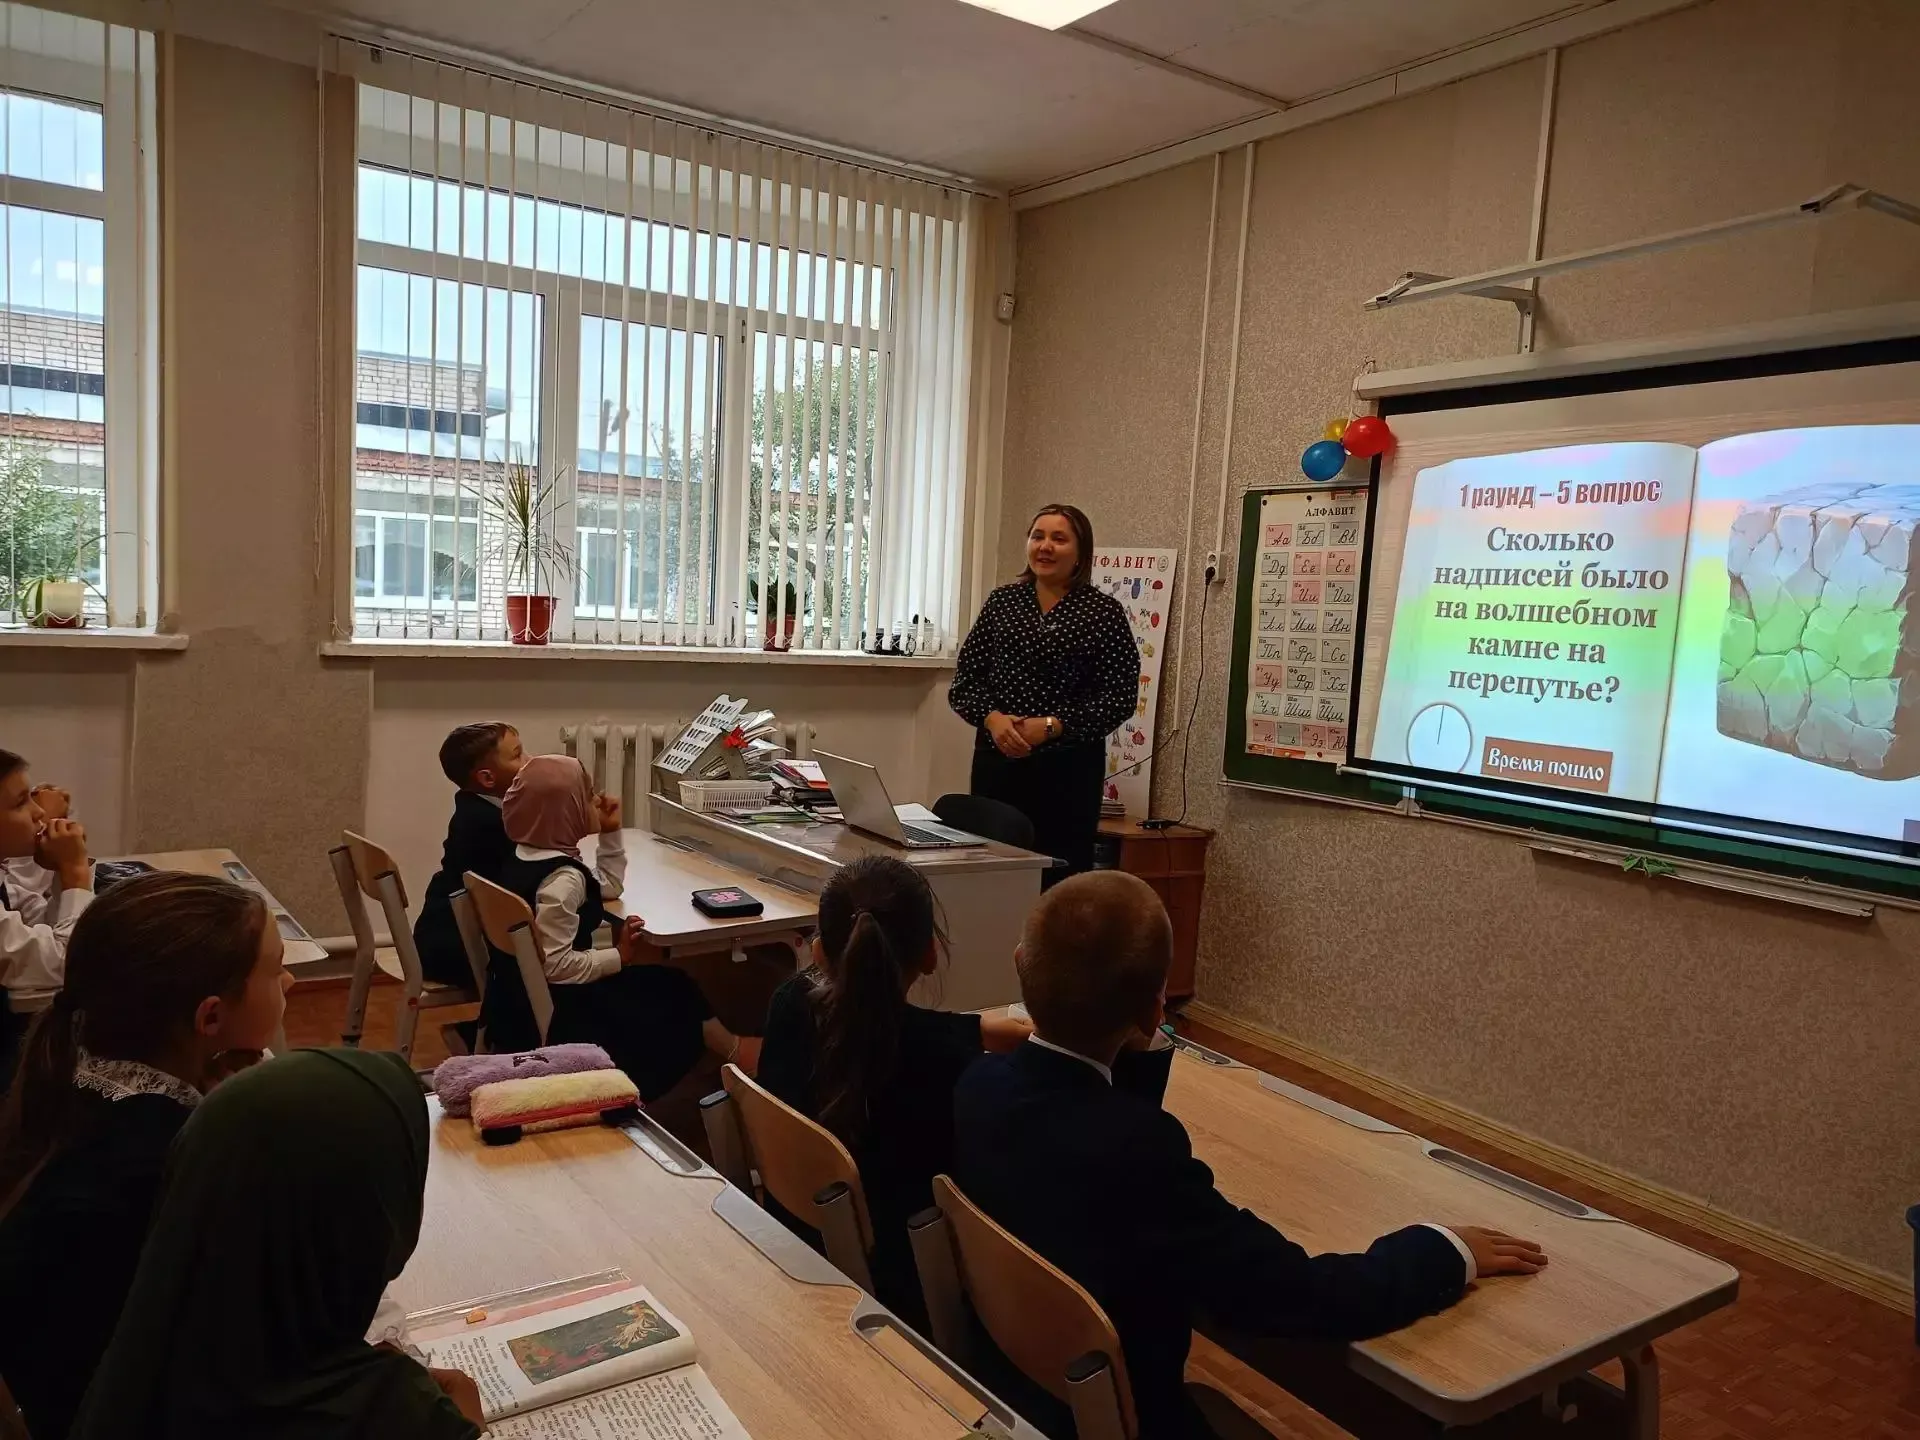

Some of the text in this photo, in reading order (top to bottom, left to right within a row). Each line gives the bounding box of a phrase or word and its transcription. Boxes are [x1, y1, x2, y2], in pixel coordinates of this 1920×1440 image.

[1460, 484, 1468, 507] 1
[1472, 485, 1536, 509] раунд
[1557, 480, 1572, 505] 5
[1575, 480, 1662, 505] вопрос
[1305, 506, 1356, 517] АЛФАВИТ
[1487, 526, 1614, 551] Сколько
[1433, 560, 1669, 590] надписей было
[1434, 598, 1658, 628] на волшебном
[1467, 636, 1606, 664] камне на
[1448, 669, 1620, 703] перепутье?
[1487, 747, 1604, 782] Время пошло
